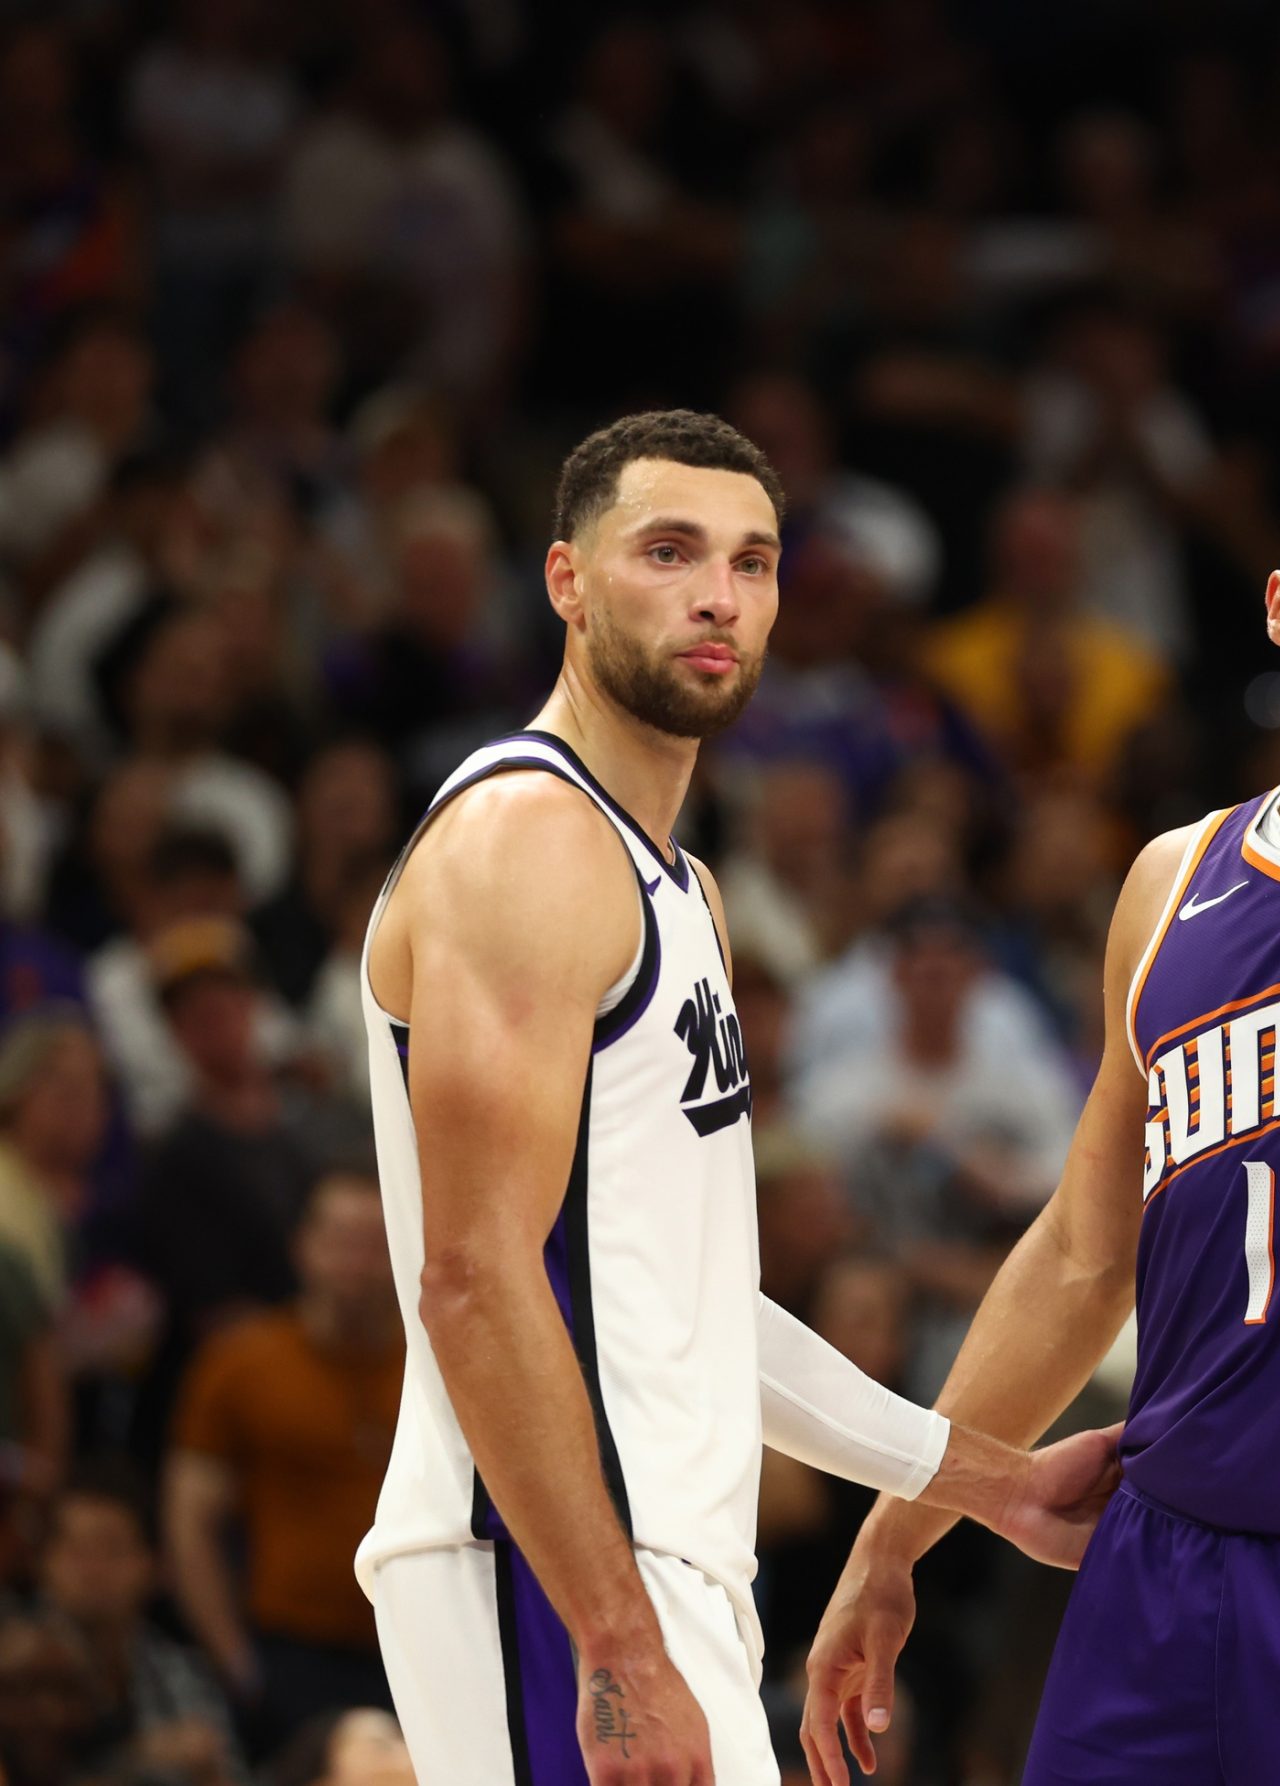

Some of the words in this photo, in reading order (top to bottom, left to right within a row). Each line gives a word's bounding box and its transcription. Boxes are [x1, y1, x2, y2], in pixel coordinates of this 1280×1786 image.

[673, 977, 750, 1104] Kin
[1242, 1161, 1275, 1324] 1
[589, 1667, 637, 1759] Saint
